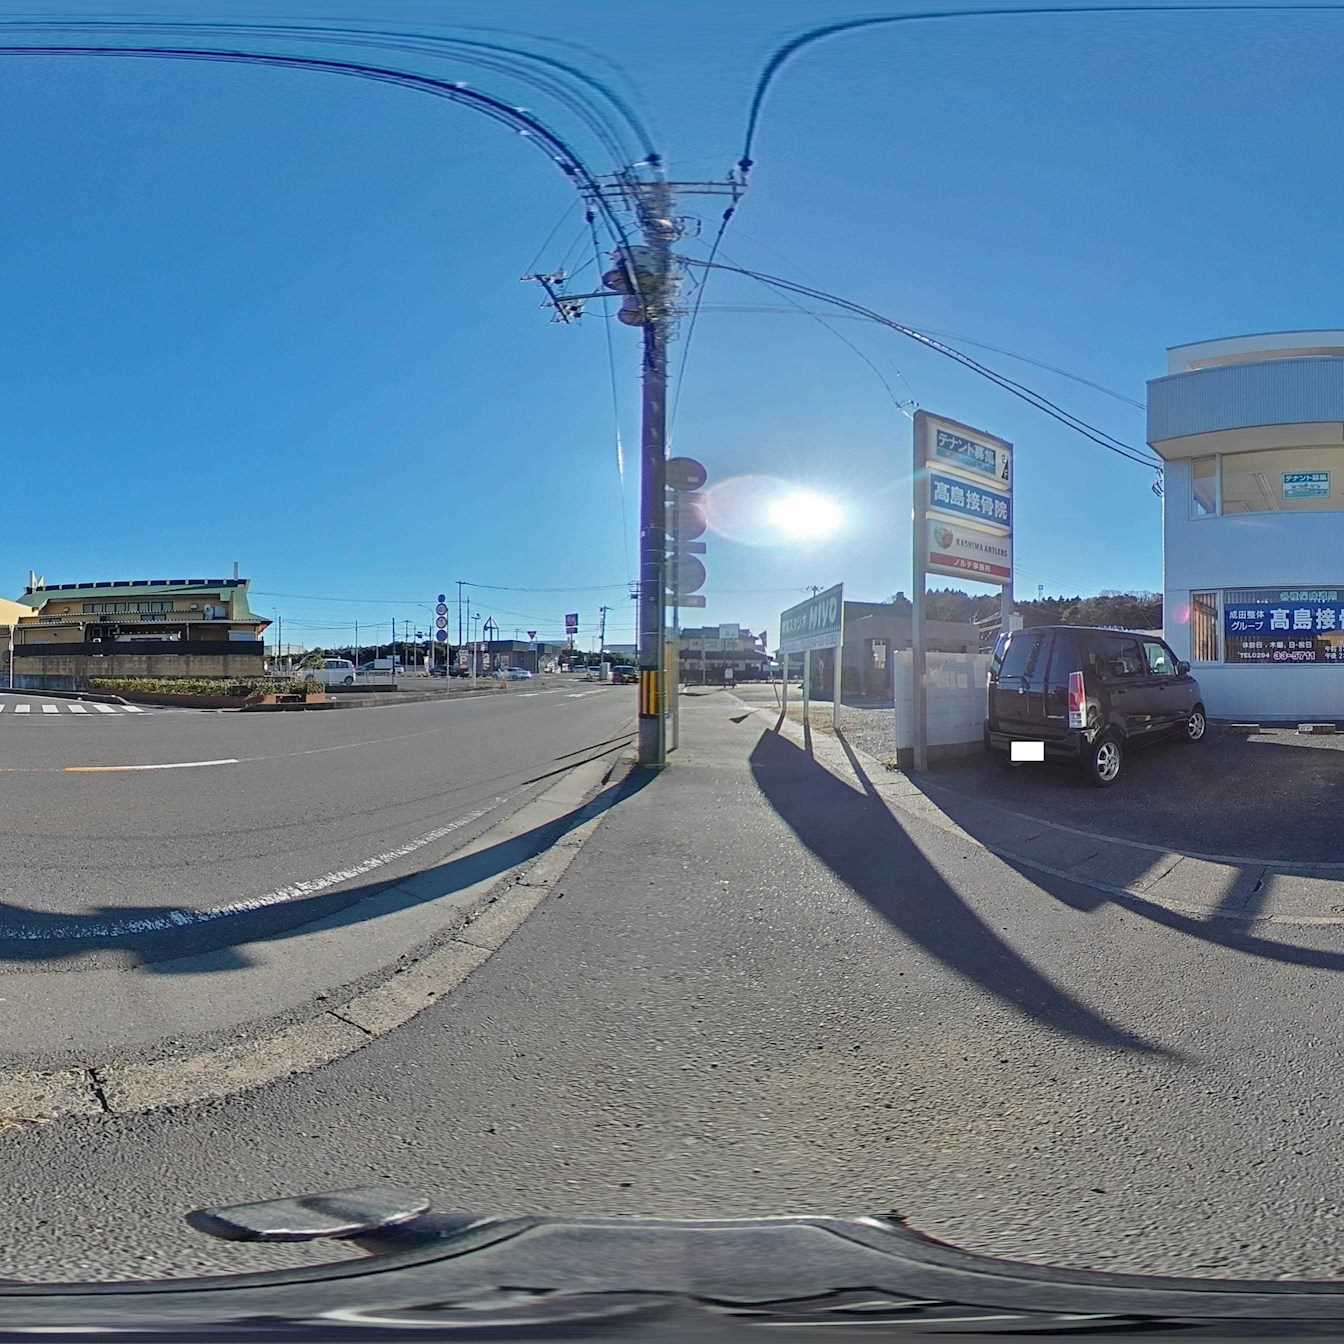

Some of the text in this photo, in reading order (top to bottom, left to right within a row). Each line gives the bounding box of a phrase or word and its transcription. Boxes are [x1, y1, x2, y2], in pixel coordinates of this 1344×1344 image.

[939, 432, 995, 466] テナント募集
[1229, 610, 1265, 620] 成田整体
[1231, 621, 1264, 631] グループ
